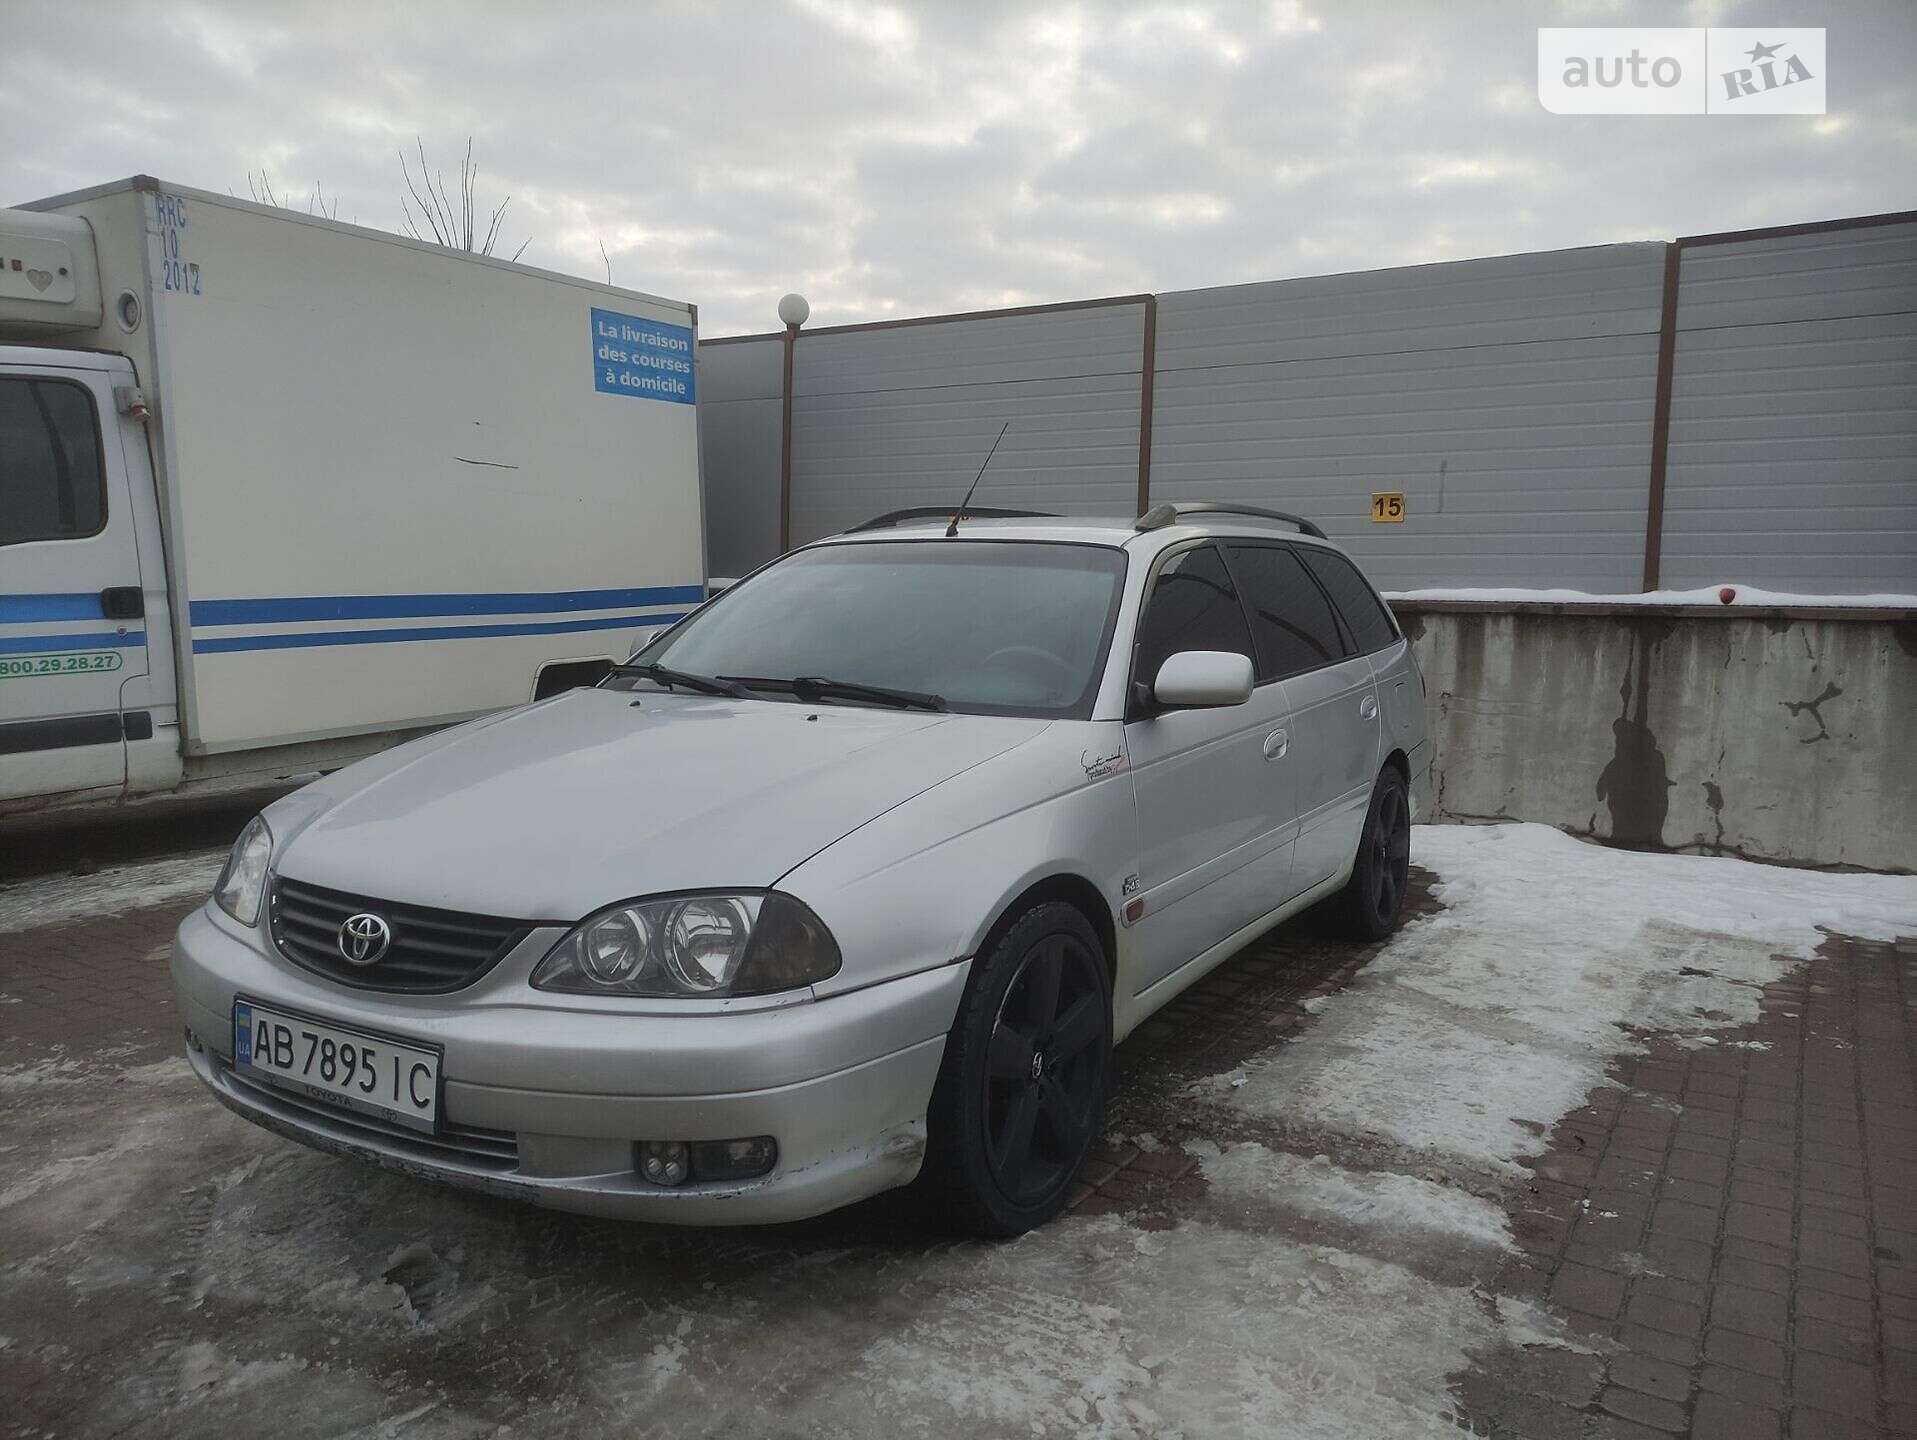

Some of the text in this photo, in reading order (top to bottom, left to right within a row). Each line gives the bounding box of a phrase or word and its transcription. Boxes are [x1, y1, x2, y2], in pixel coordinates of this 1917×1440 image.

[160, 228, 178, 259] 10
[599, 321, 688, 351] La livraison
[599, 345, 690, 373] des courses
[606, 368, 686, 394] à domicile
[1375, 497, 1401, 517] 15
[239, 1040, 250, 1057] UA
[254, 1019, 432, 1109] AB 7895 IC
